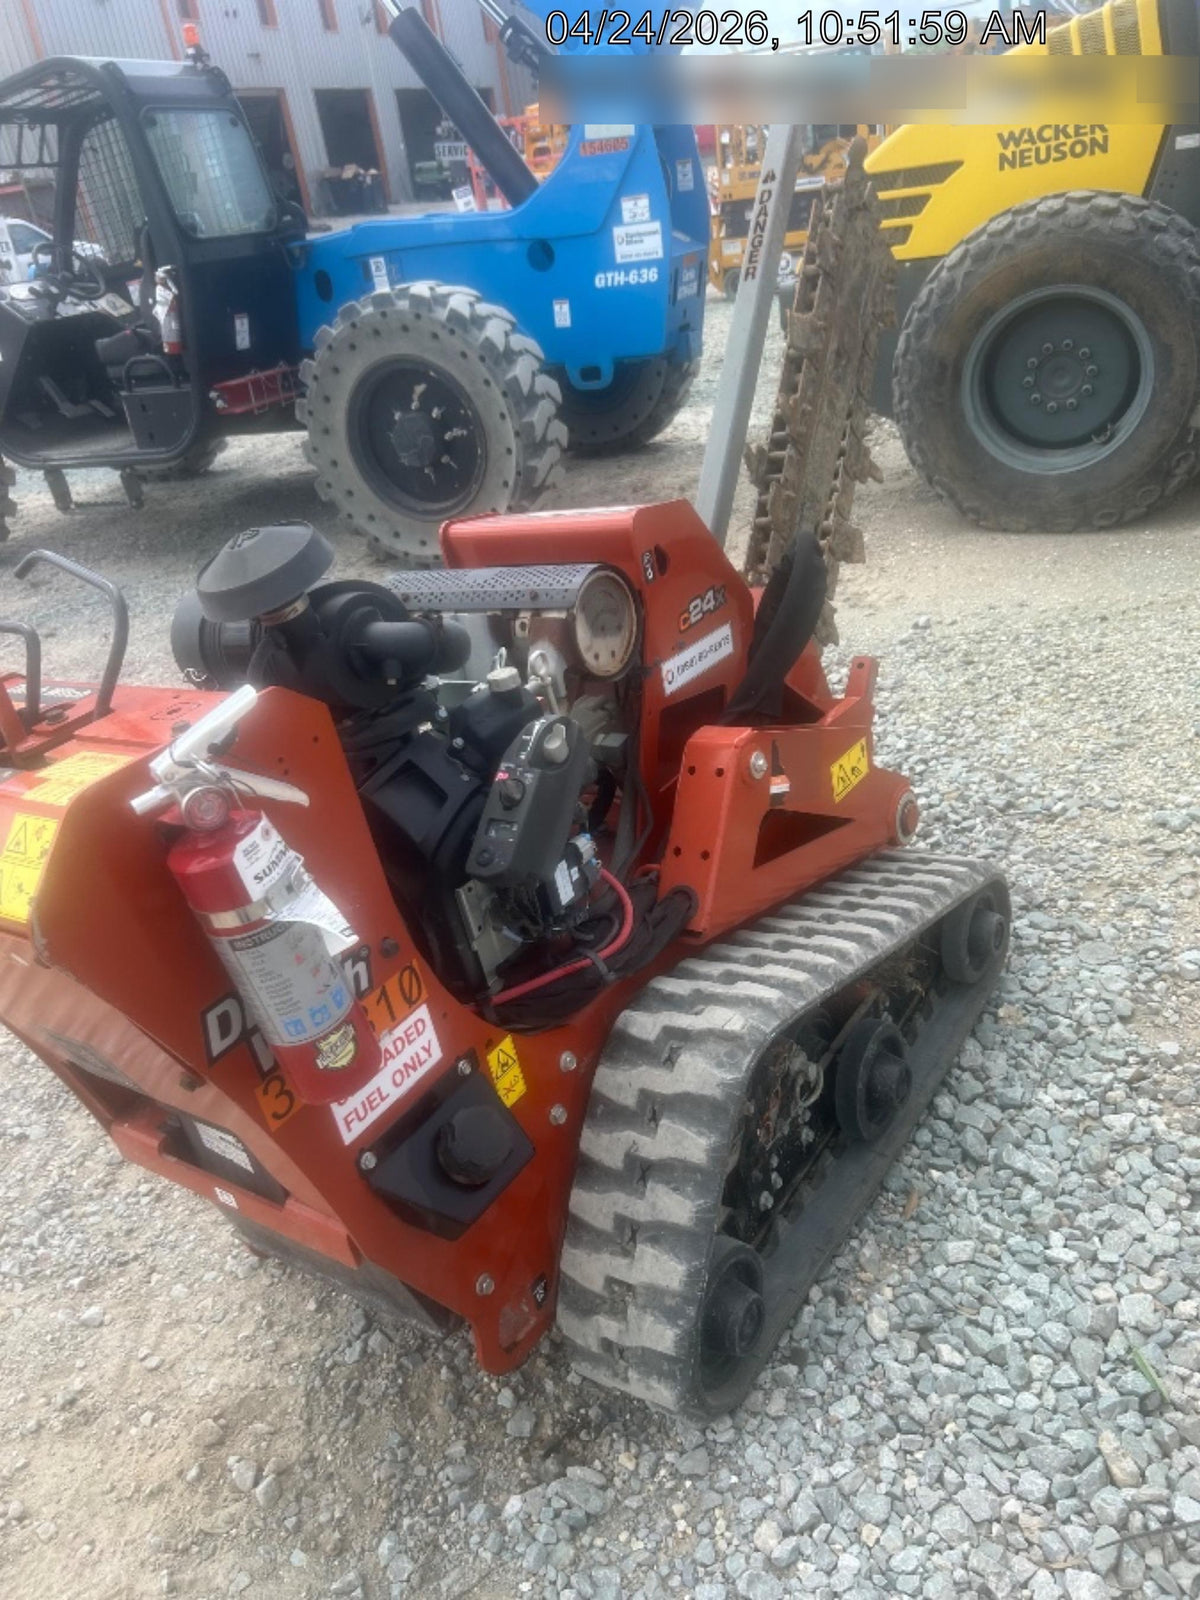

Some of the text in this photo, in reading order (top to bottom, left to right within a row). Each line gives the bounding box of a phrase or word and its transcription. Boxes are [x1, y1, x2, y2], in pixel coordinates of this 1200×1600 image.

[437, 145, 468, 158] SERVIC
[997, 124, 1108, 150] WACKER
[999, 135, 1108, 172] NEUSON
[743, 189, 772, 282] DANGER
[595, 267, 659, 289] GTH-636
[343, 1085, 390, 1133] FUEL
[391, 1039, 434, 1089] ONLY
